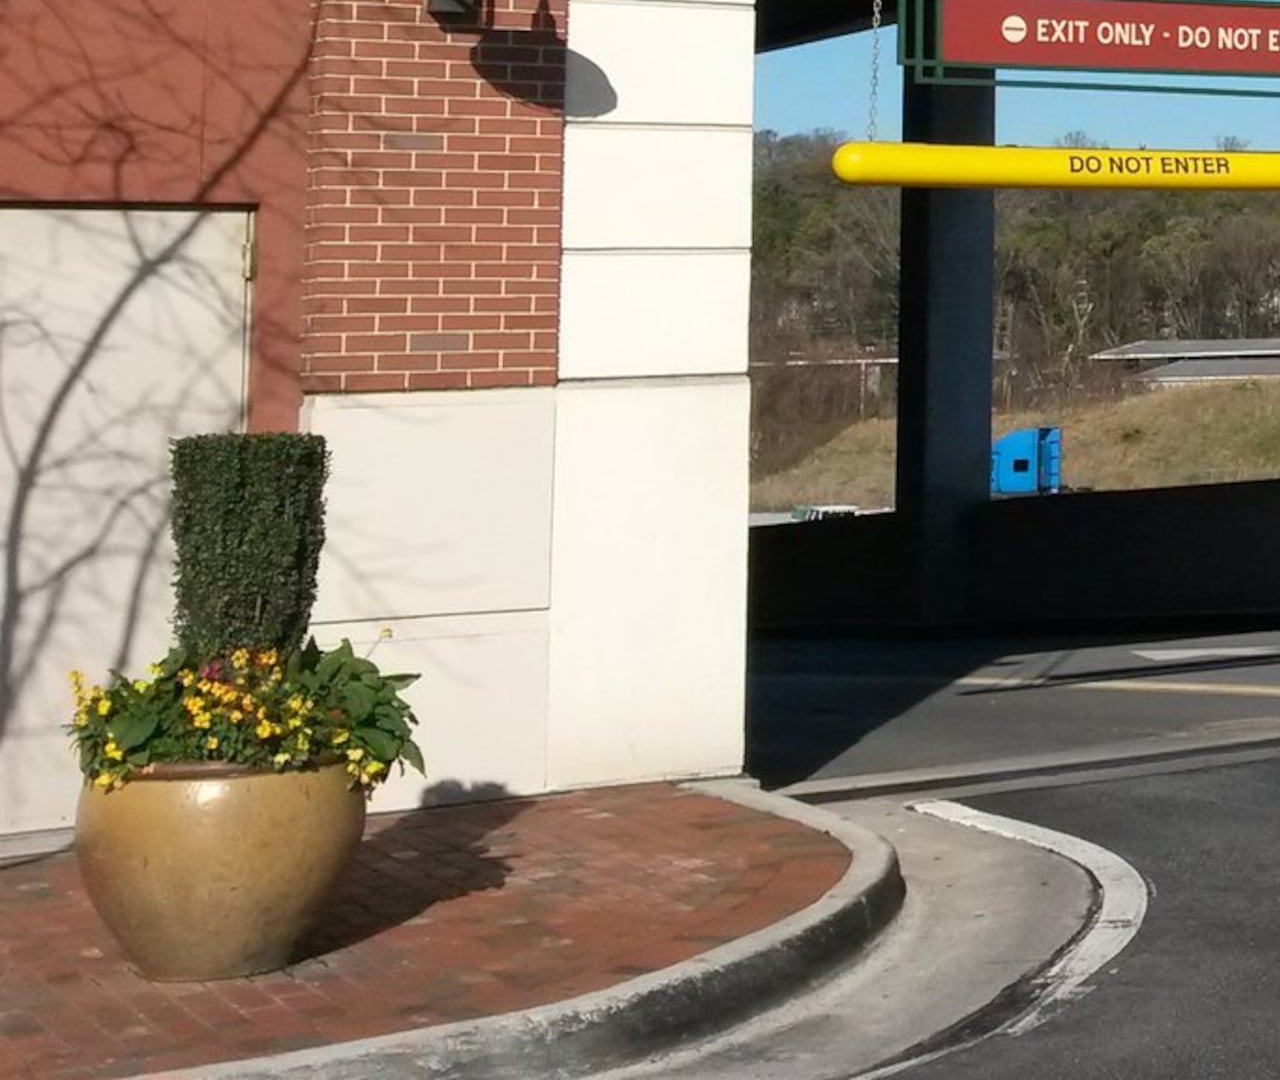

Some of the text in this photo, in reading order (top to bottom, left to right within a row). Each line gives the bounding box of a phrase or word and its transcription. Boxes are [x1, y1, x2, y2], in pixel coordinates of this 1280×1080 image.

[1036, 18, 1089, 44] EXIT
[1096, 21, 1155, 47] ONLY
[1177, 25, 1211, 49] DO
[1217, 27, 1262, 51] NOT
[1069, 155, 1231, 176] DO NOT ENTER
